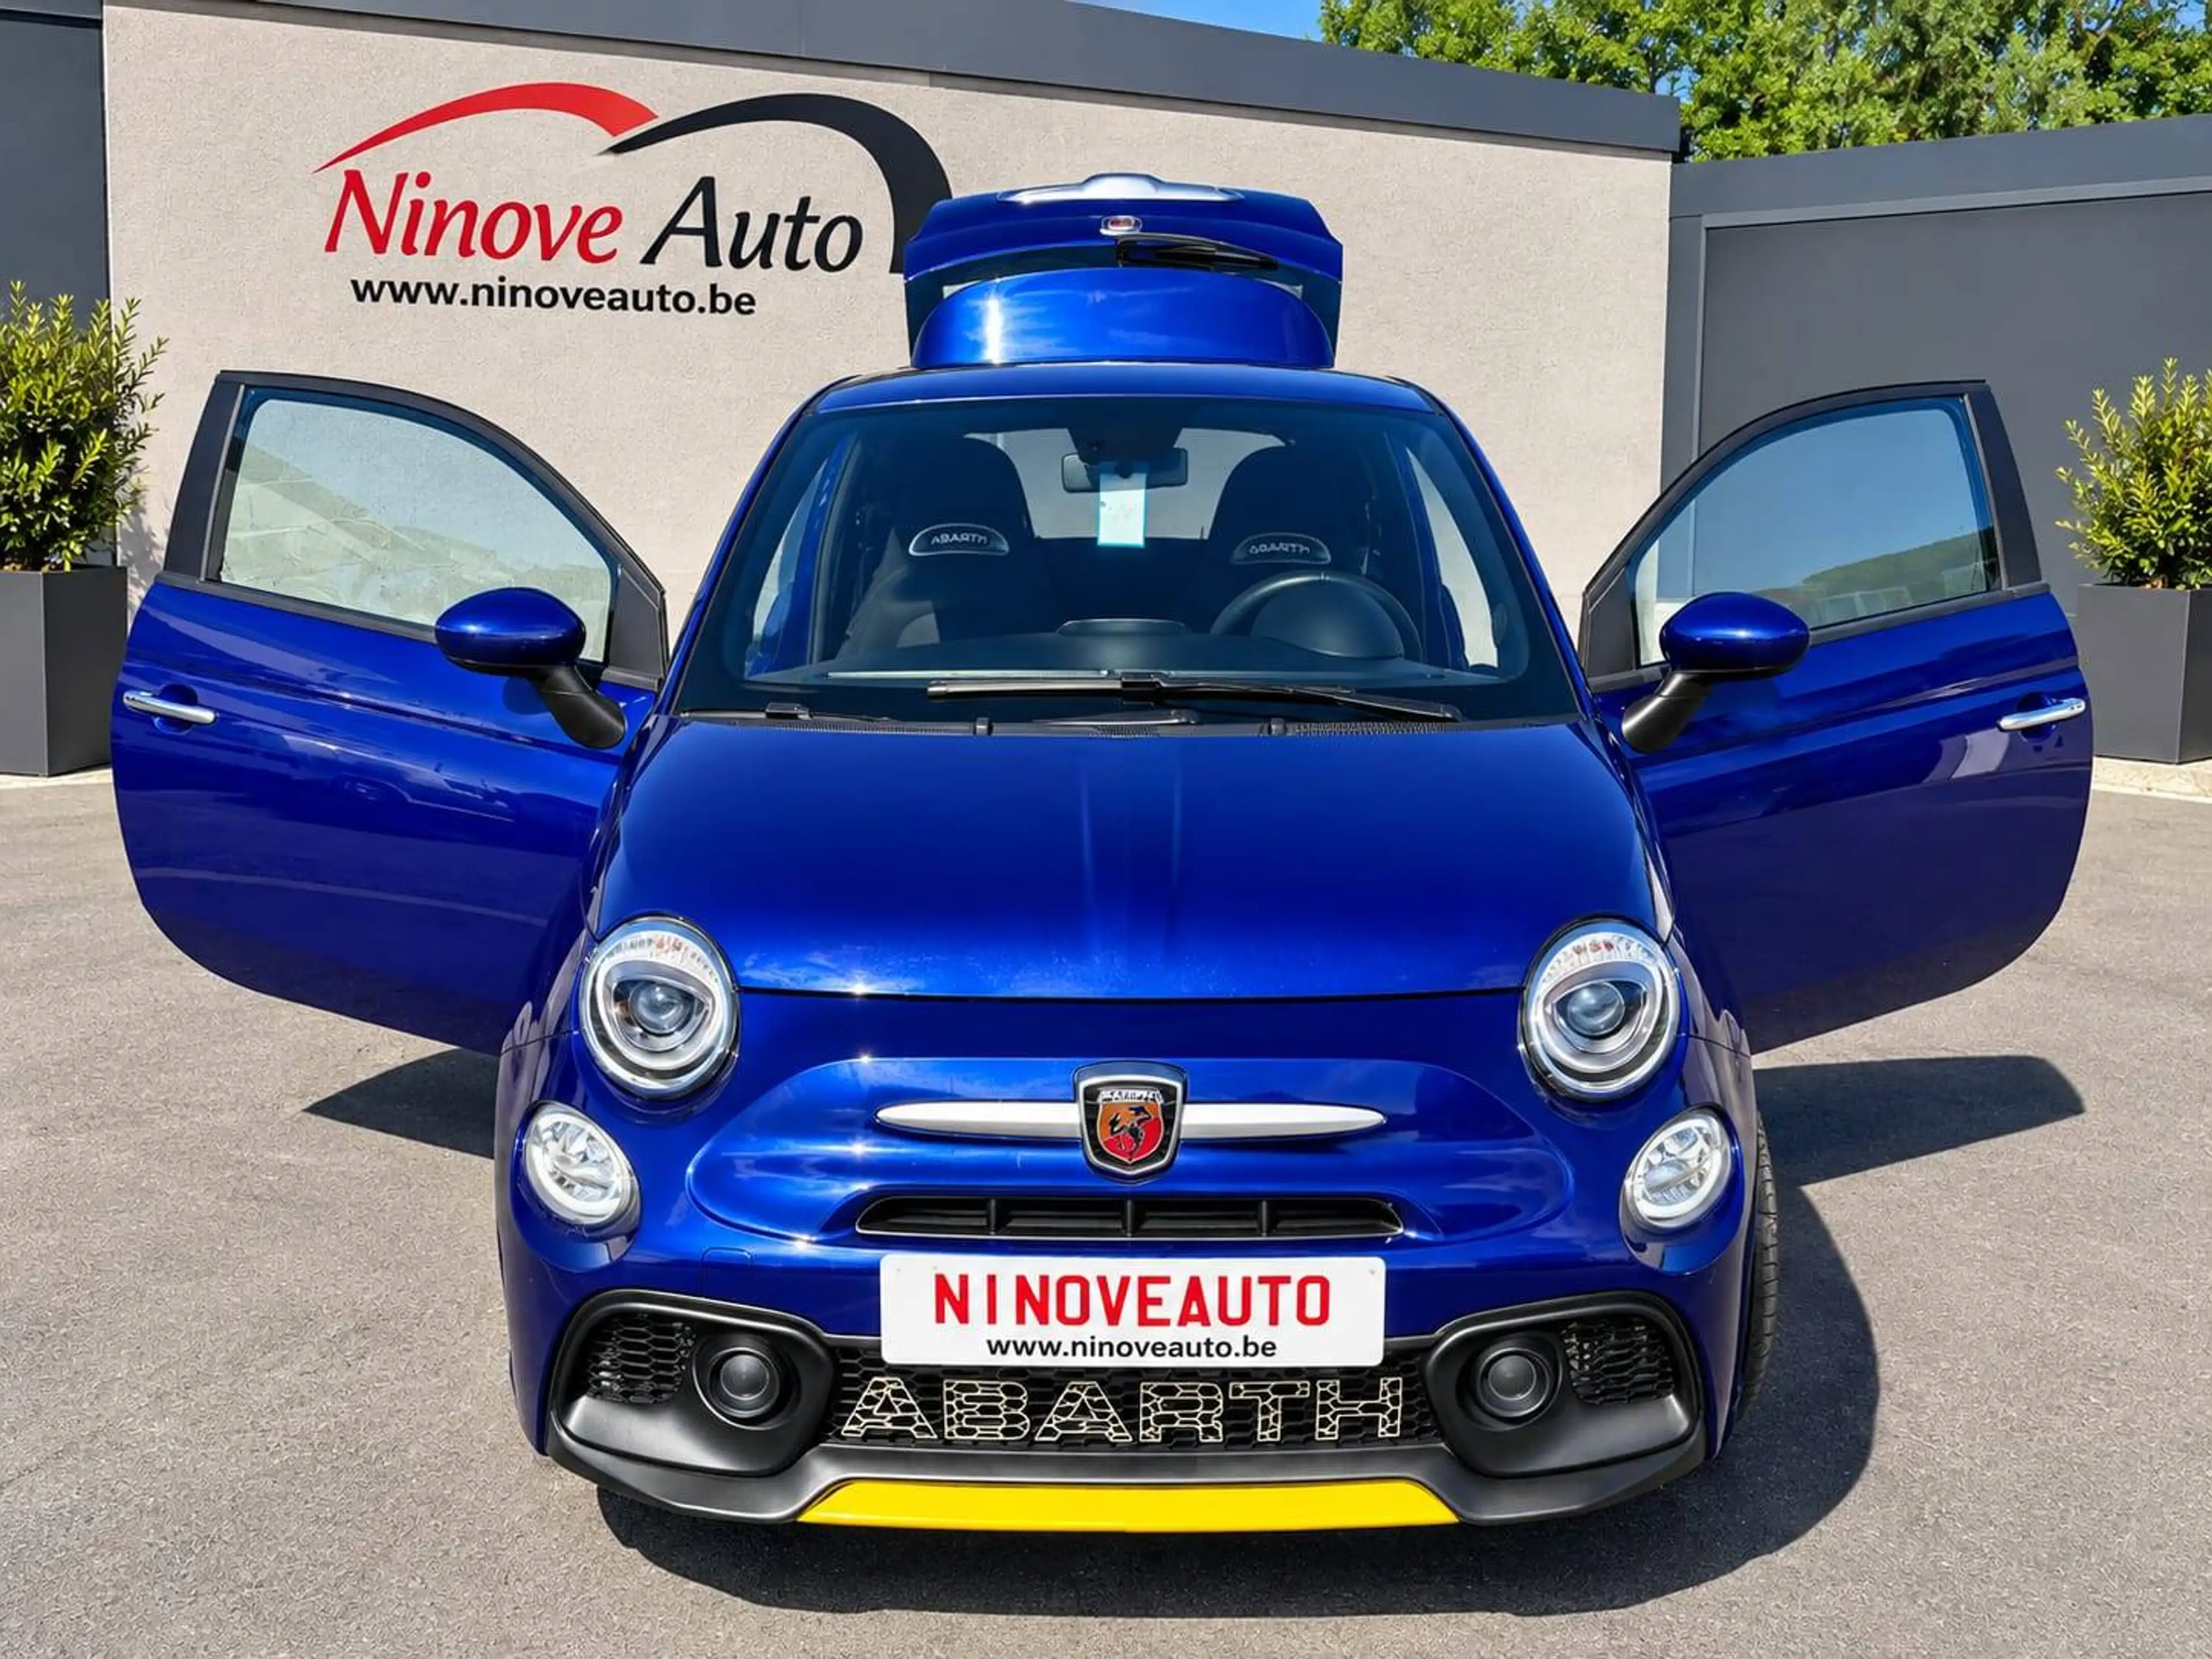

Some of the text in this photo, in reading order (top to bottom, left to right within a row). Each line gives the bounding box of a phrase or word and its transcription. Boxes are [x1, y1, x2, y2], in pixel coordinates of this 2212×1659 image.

[324, 168, 863, 272] Ninove Auto
[350, 275, 756, 316] www.ninoveauto.be
[986, 1335, 1277, 1358] www.ninoveauto.be
[840, 1376, 1403, 1444] ABARTH
